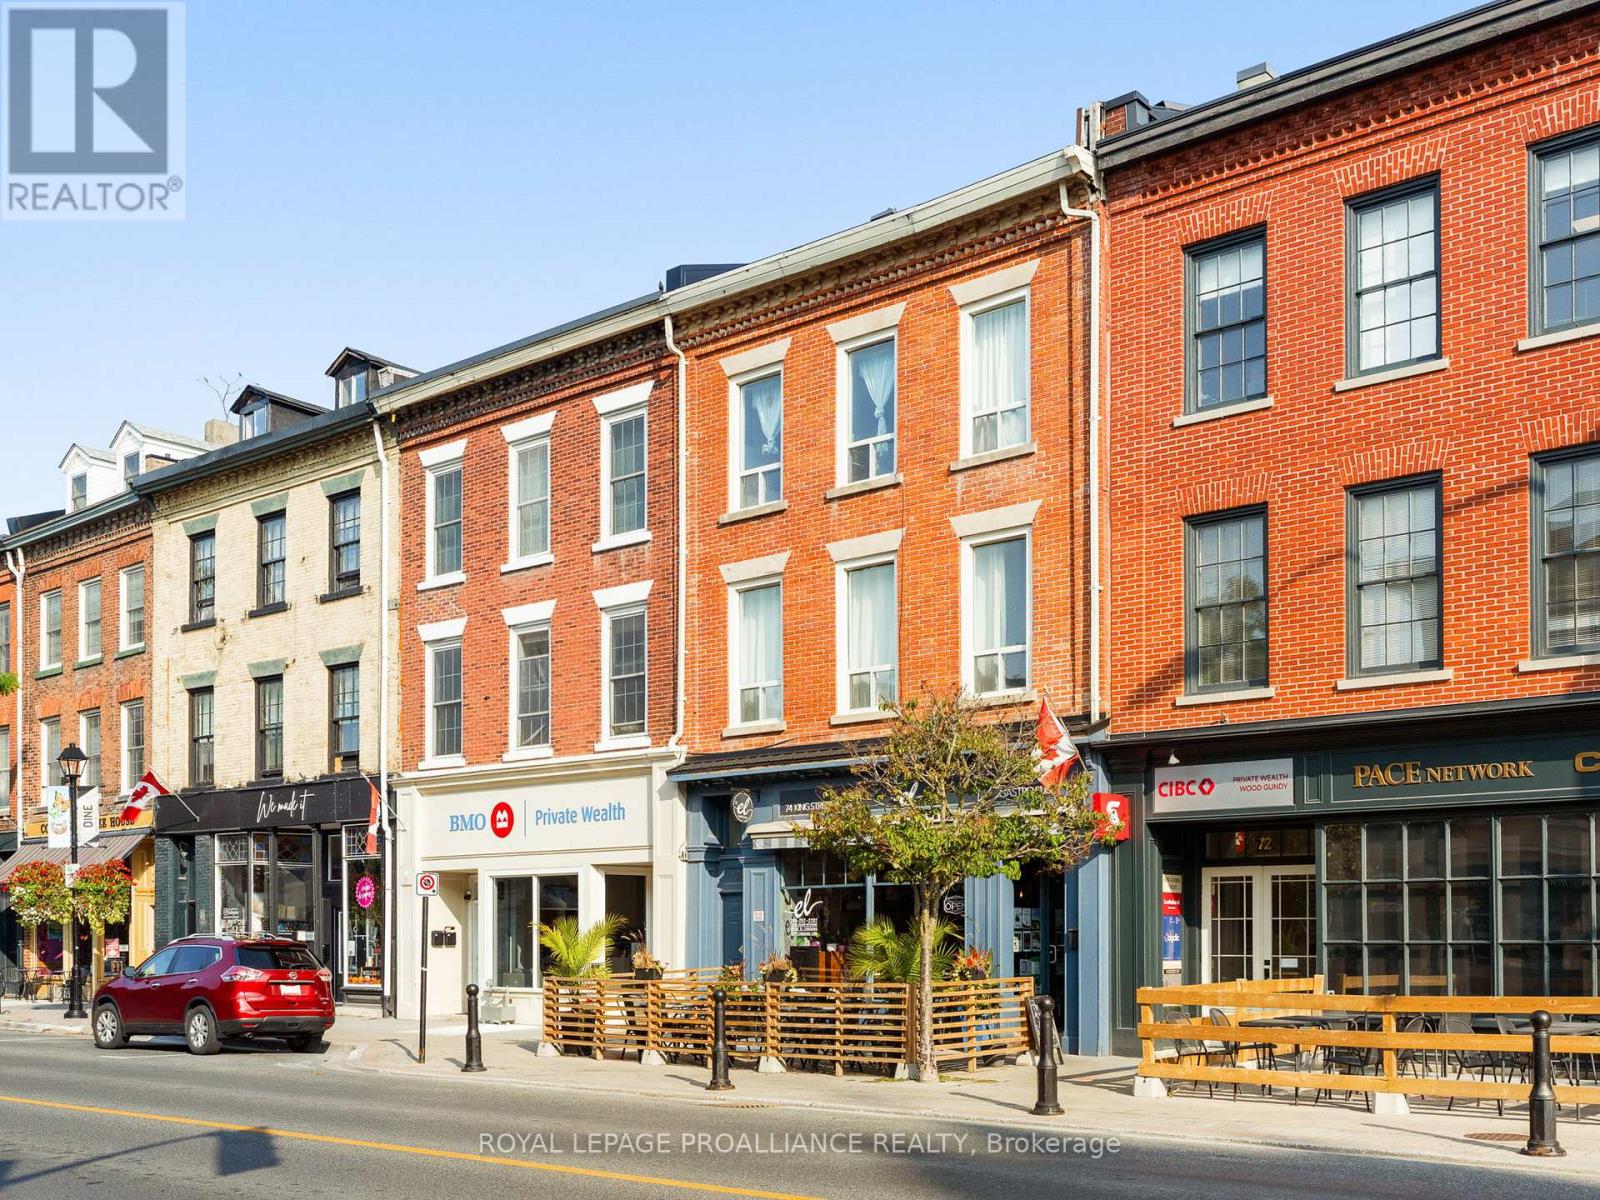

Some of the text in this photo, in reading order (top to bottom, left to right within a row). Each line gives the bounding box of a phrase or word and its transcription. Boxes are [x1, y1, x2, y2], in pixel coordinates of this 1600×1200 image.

[1232, 773, 1289, 783] PRIVATE WEALTH
[1352, 760, 1535, 788] PACE NETWORK
[1158, 779, 1197, 798] CIBC
[1239, 782, 1289, 793] WOOD GUNDY
[83, 804, 93, 828] DINE
[449, 802, 626, 832] BMO Private Wealth
